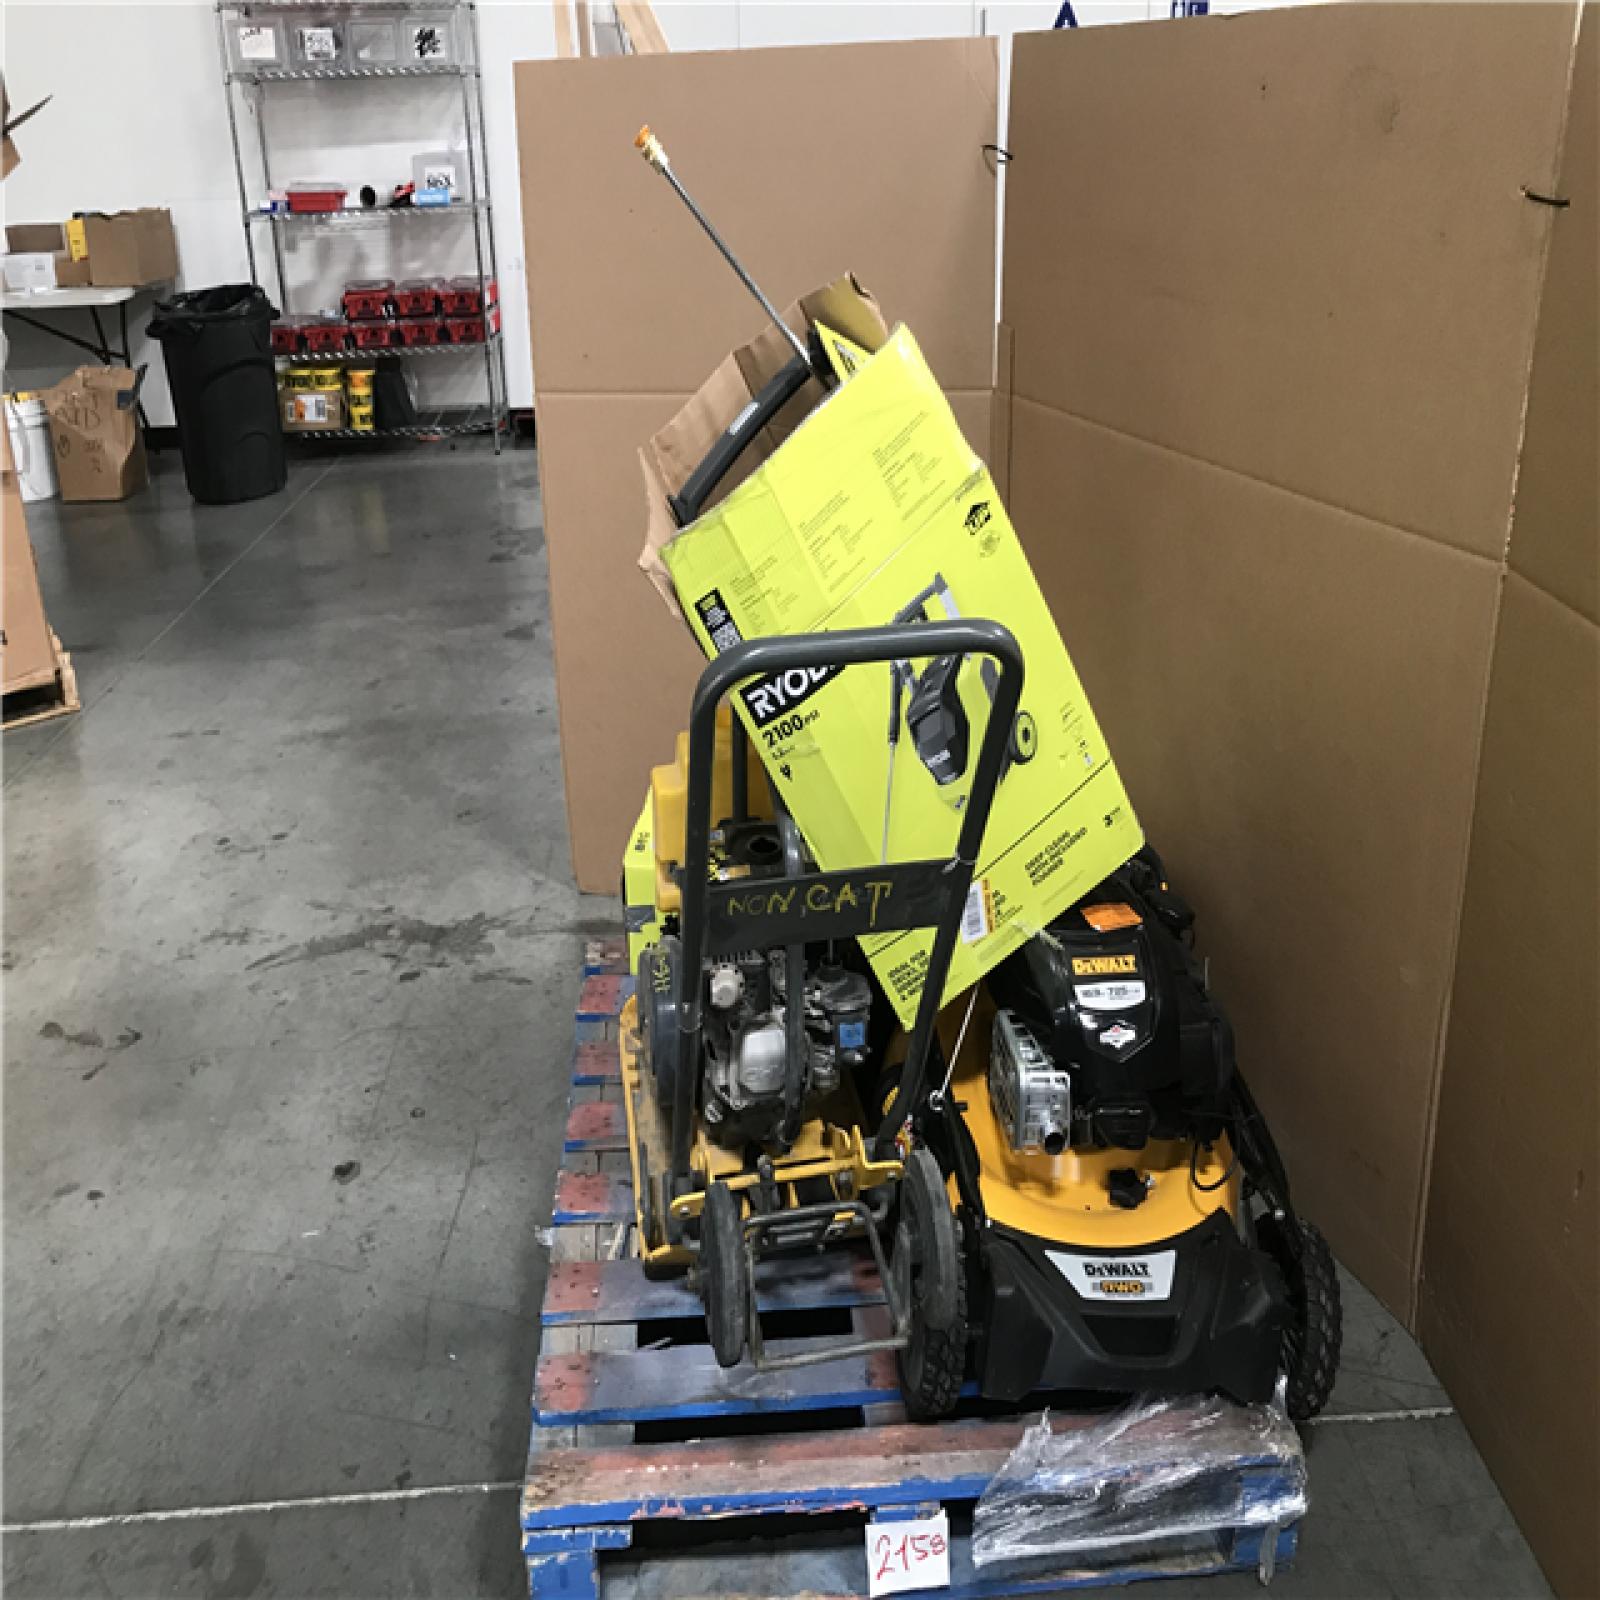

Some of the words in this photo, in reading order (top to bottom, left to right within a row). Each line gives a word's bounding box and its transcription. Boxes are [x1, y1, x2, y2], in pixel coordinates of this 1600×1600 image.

[747, 664, 836, 718] RYO
[763, 714, 804, 748] 2100
[728, 886, 796, 916] NON
[806, 881, 893, 928] CAT
[875, 1533, 946, 1581] 2158
